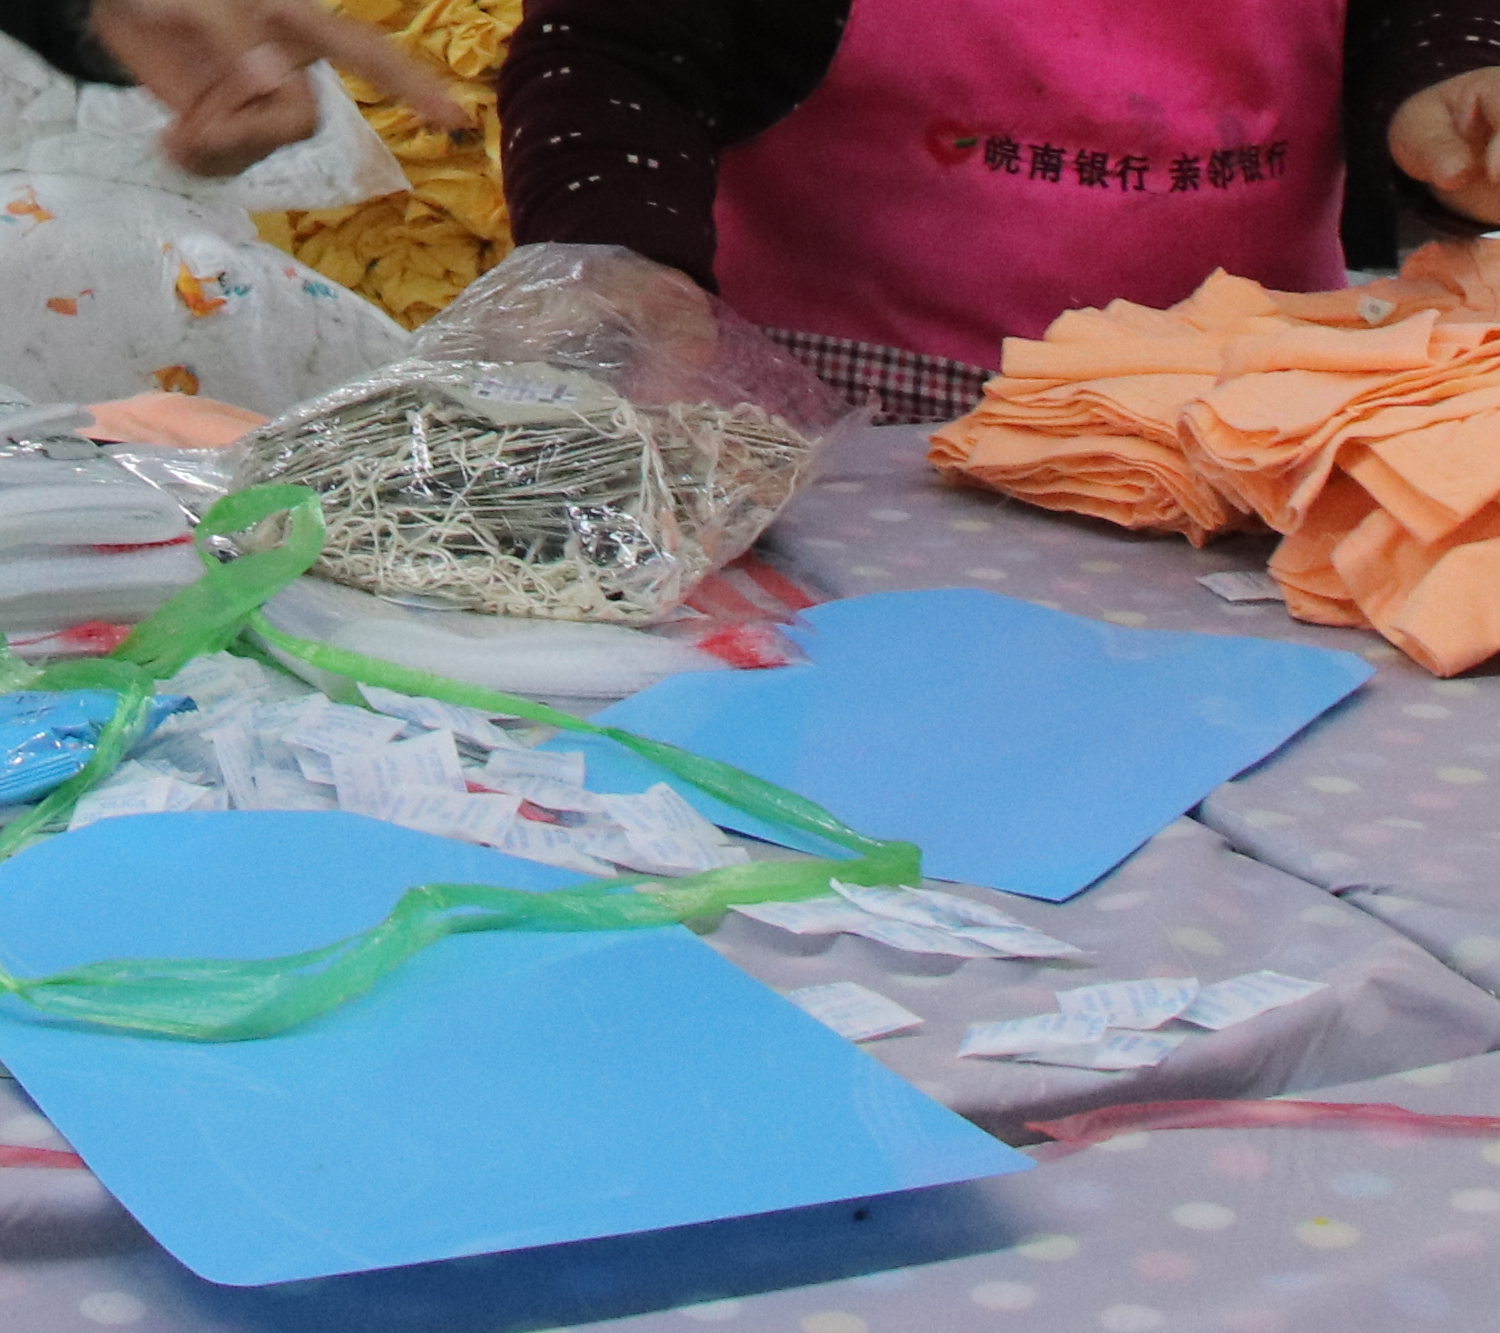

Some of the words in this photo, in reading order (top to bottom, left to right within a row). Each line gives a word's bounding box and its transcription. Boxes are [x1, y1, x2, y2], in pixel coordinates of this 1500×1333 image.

[984, 135, 1150, 192] 皖南银行
[1169, 139, 1288, 192] 亲邻银行
